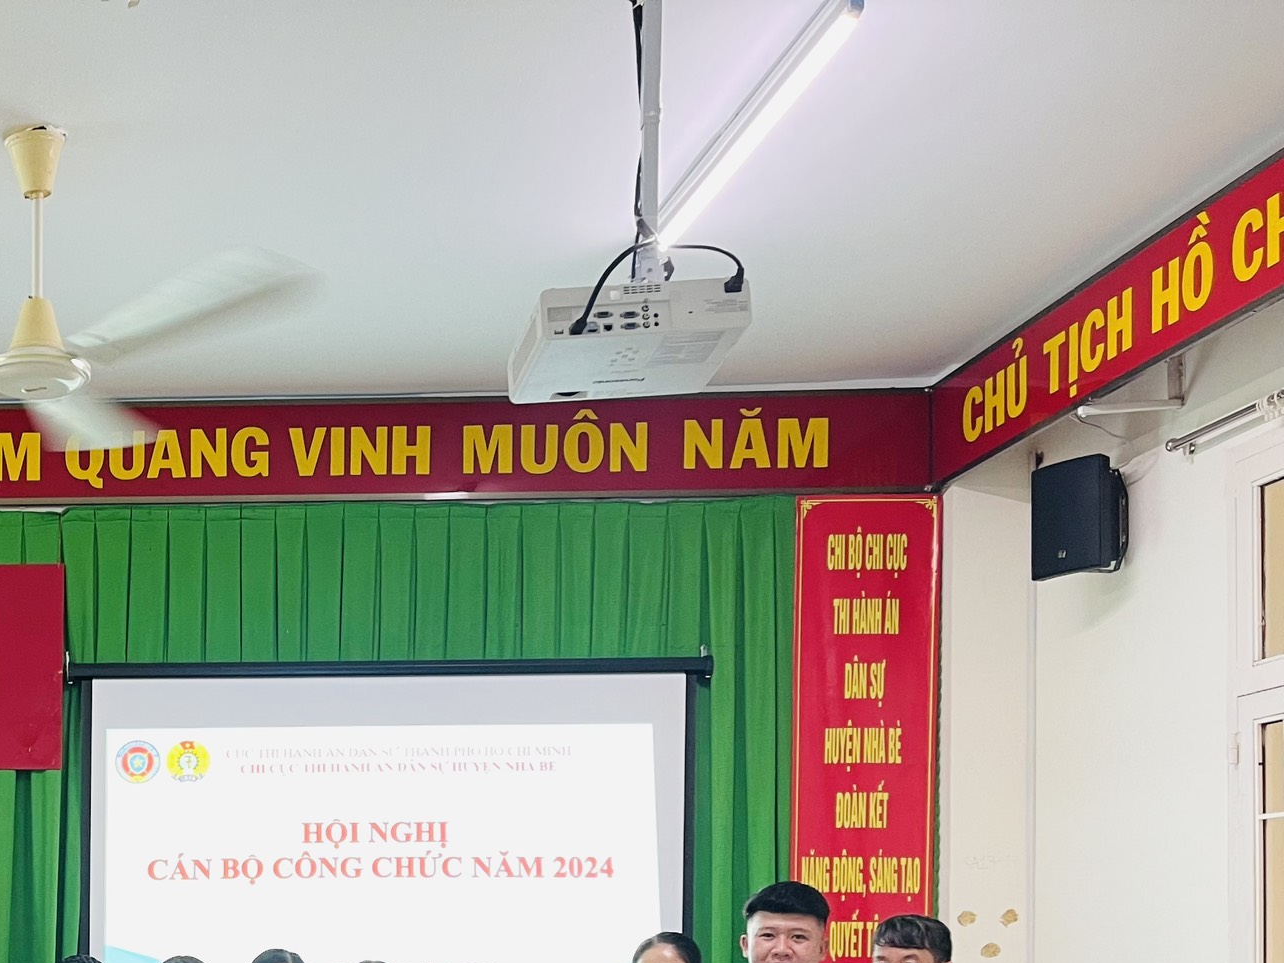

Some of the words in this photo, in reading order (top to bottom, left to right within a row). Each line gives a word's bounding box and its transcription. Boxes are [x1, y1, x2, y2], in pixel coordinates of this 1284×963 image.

[962, 336, 1027, 443] CHỦ
[1043, 286, 1133, 398] TỊCH
[1151, 210, 1214, 334] HỒ
[65, 429, 269, 489] QUANG
[289, 425, 430, 476] VINH
[462, 409, 648, 475] MUÔN
[683, 407, 830, 470] NĂM
[827, 534, 845, 570] CHI
[848, 526, 863, 578] BỘ
[866, 534, 883, 570] CHI
[886, 534, 908, 578] CỤC
[833, 598, 850, 635] THI
[852, 591, 883, 635] HÀNH
[884, 591, 900, 635] ÁN
[844, 655, 867, 699] DÂN
[869, 659, 886, 708] SỰ
[824, 719, 861, 772] HUYỆN
[863, 719, 886, 764] NHÀ
[888, 719, 902, 764] BÈ
[835, 784, 867, 829] ĐOÀN
[868, 780, 889, 829] KẾT
[302, 818, 359, 849] HỘI
[368, 820, 449, 849] NGHỊ
[147, 852, 212, 881] CÁN
[220, 854, 264, 885] BỘ
[272, 850, 364, 880] CÔNG
[371, 850, 463, 879] CHỨC
[471, 850, 544, 879] NĂM
[553, 855, 615, 879] 2024
[801, 849, 831, 893] NĂNG
[832, 849, 866, 901] ĐỘNG,
[869, 849, 898, 894] SÁNG
[900, 857, 921, 902] TẠO
[829, 909, 865, 962] QUYẾT
